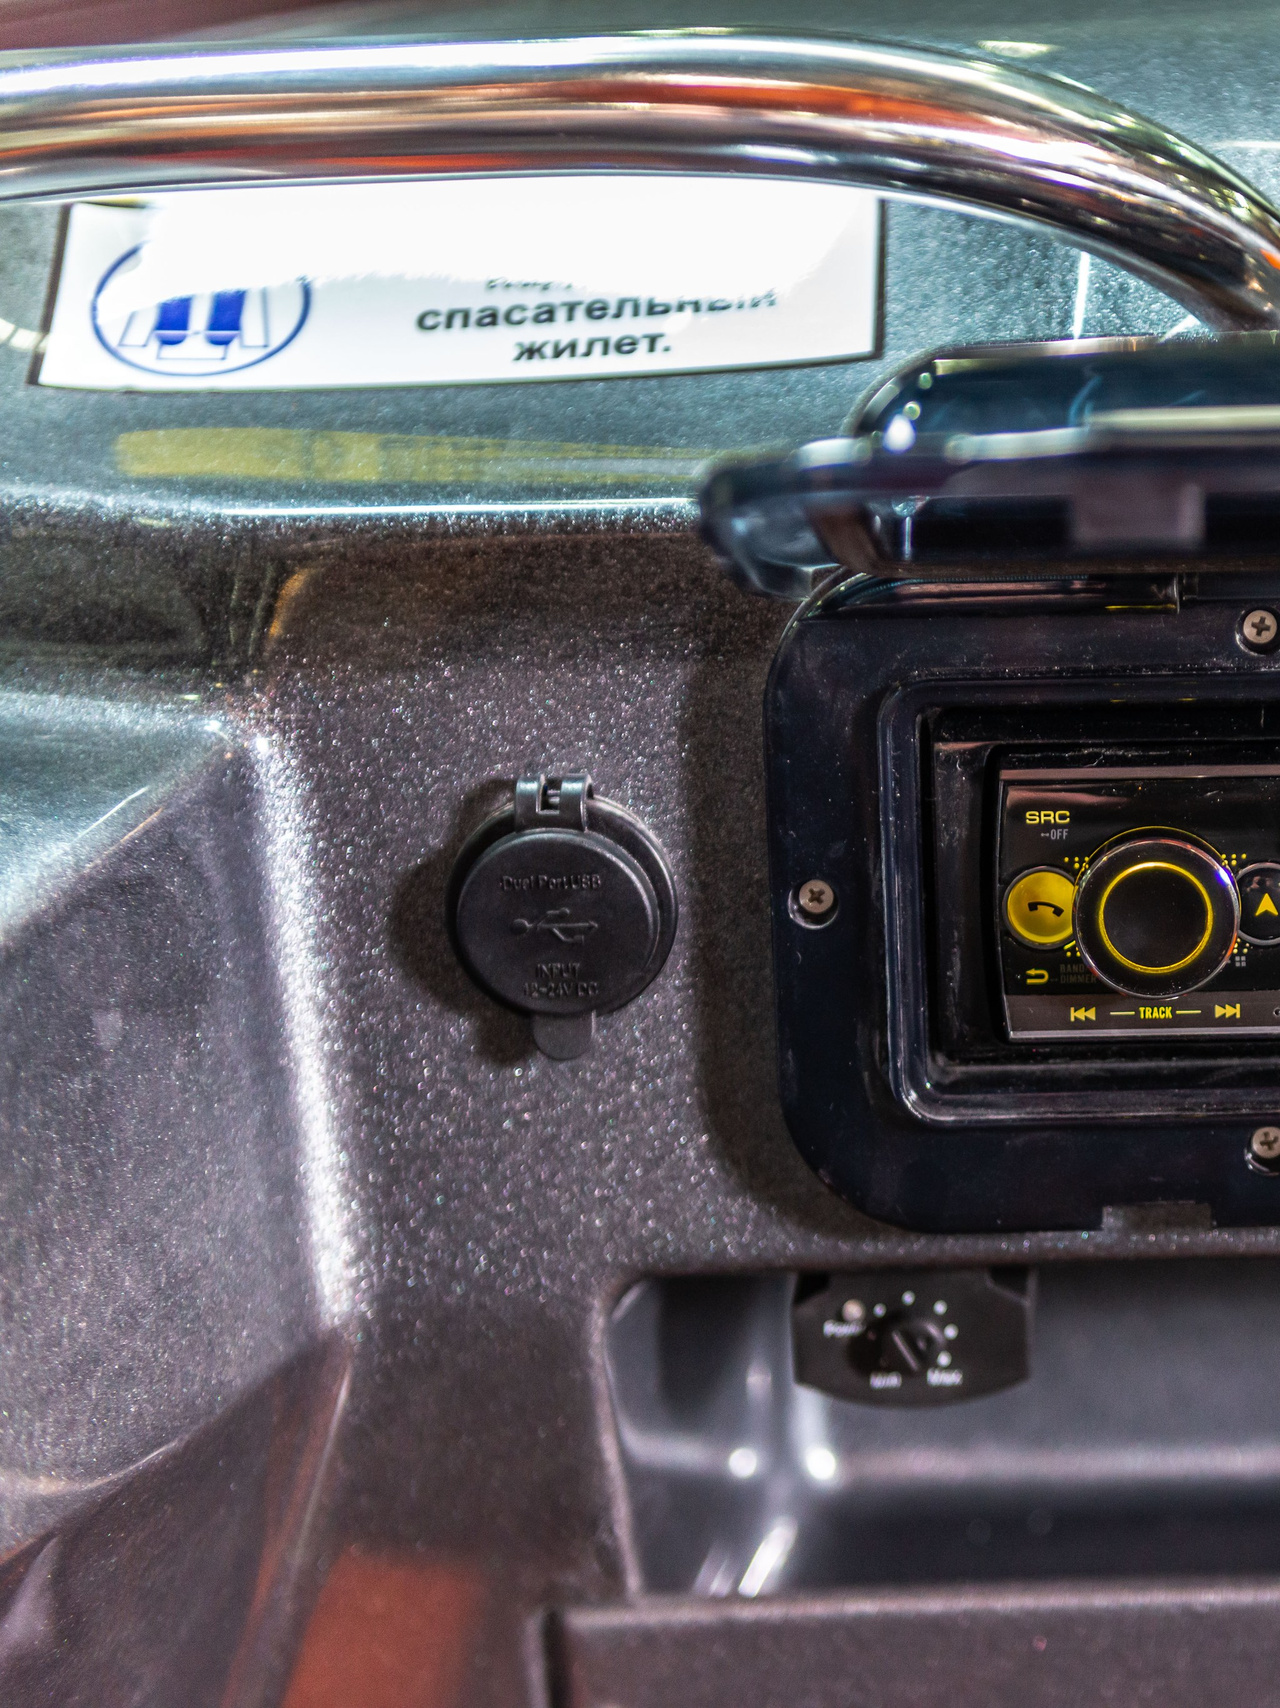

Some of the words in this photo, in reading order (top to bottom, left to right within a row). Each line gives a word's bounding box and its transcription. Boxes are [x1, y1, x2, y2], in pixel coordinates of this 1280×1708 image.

[513, 332, 671, 361] жилет.
[1025, 810, 1071, 825] SRC
[1050, 828, 1069, 841] OFF
[570, 873, 602, 890] USB
[536, 962, 581, 978] INPUT
[1139, 1006, 1173, 1020] TRACK
